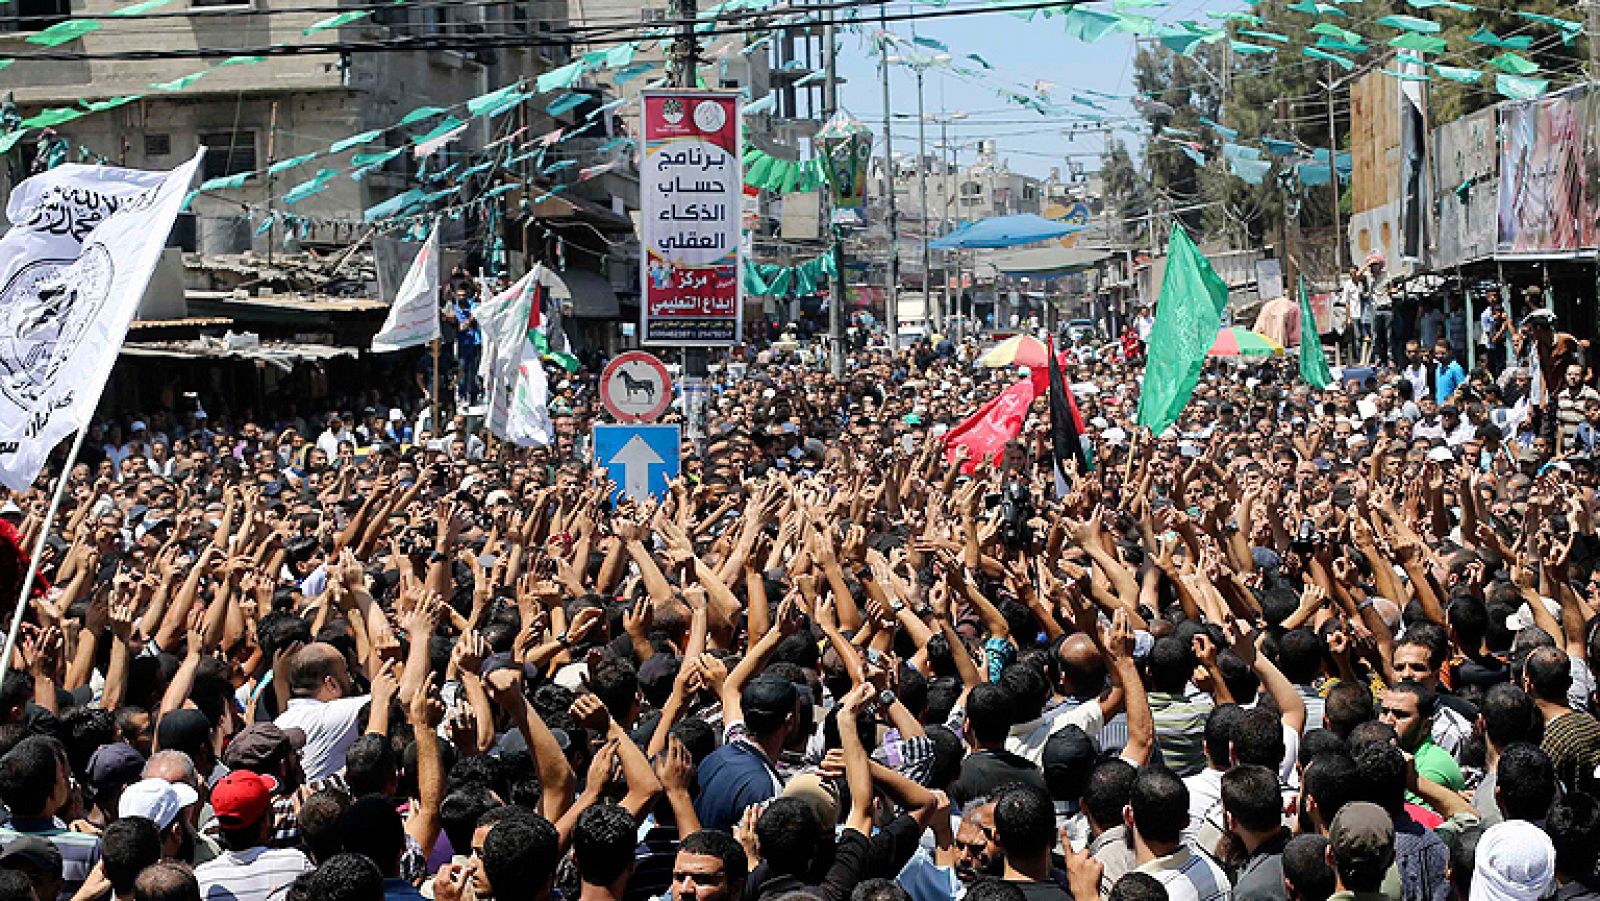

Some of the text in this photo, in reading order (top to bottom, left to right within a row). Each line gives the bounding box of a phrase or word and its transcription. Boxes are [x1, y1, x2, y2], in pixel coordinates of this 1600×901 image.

[658, 148, 725, 171] برنامج
[658, 176, 725, 198] حساب
[658, 204, 725, 220] الذكاء
[658, 231, 725, 254] العقلي
[677, 271, 707, 289] مركز
[651, 295, 734, 315] إبداع التعليمي
